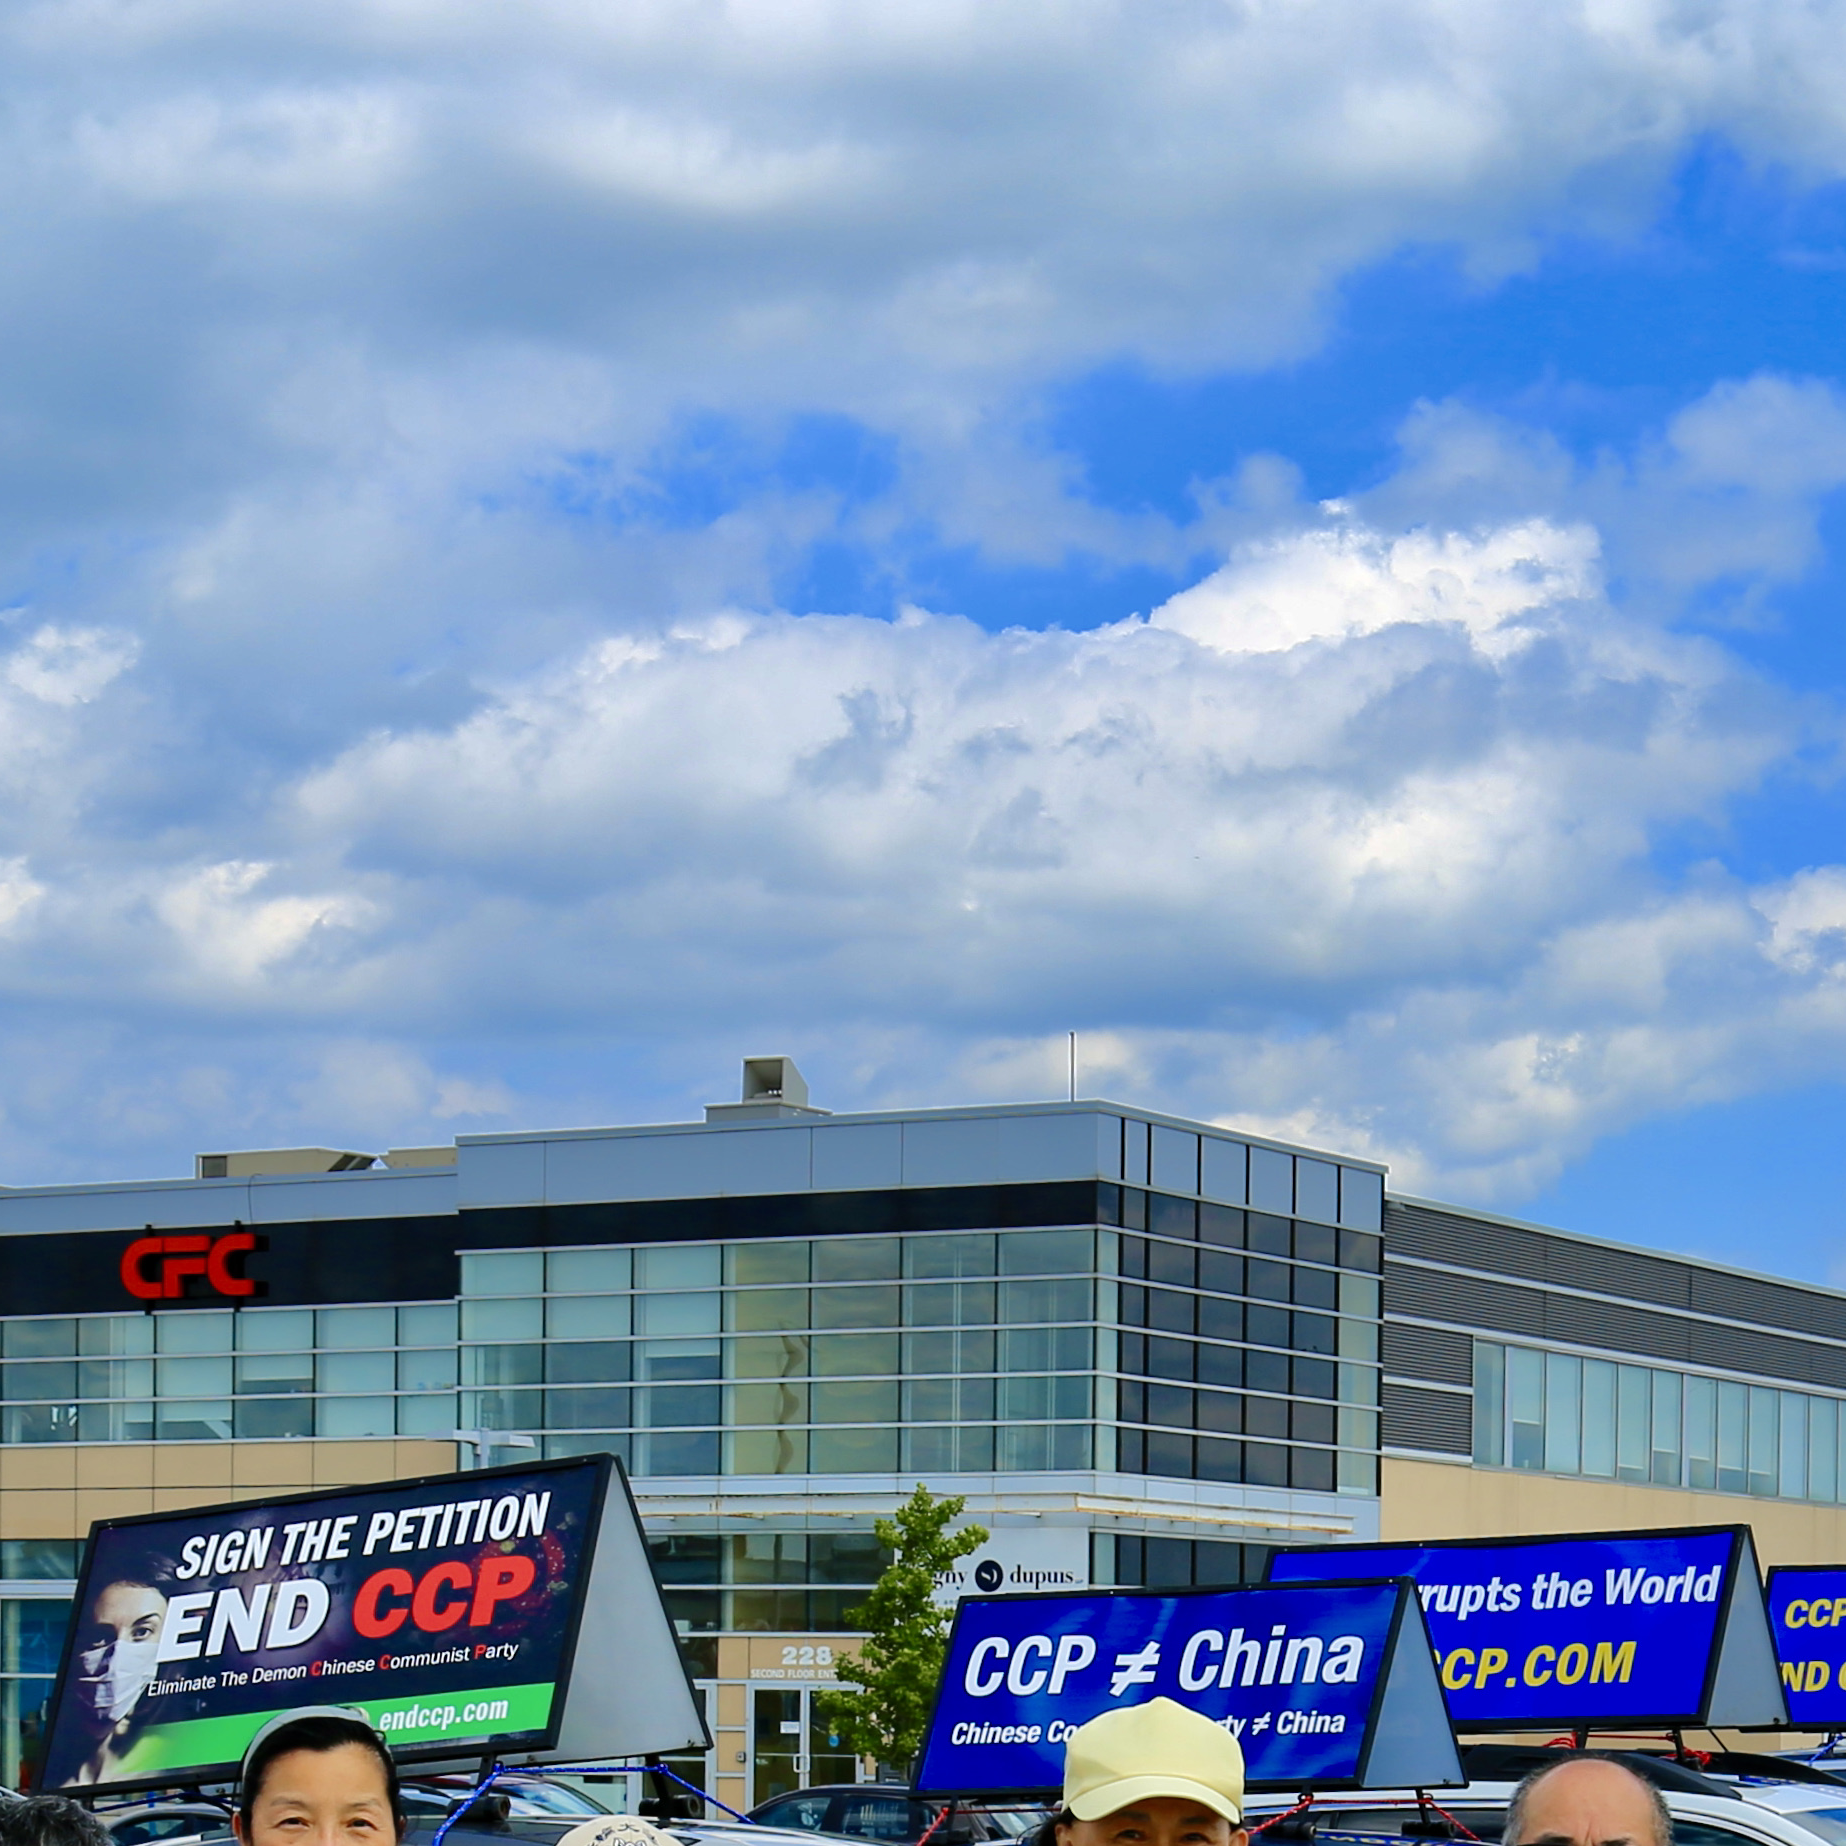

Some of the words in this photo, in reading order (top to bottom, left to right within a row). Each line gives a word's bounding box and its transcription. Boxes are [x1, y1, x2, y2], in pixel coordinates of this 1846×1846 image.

[120, 1234, 256, 1299] CFC
[176, 1527, 278, 1578] SIGN
[280, 1515, 358, 1563] THE
[364, 1491, 552, 1556] PETITION
[1010, 1564, 1074, 1589] dupuis
[1417, 1575, 1521, 1621] rupts
[1532, 1571, 1592, 1610] the
[1606, 1565, 1722, 1605] World
[157, 1578, 329, 1663] END
[353, 1555, 536, 1640] CCP
[148, 1673, 218, 1698] Eliminate
[221, 1669, 250, 1689] The
[251, 1664, 308, 1684] Demon
[311, 1656, 375, 1680] Chinese
[379, 1646, 471, 1673] Communist
[475, 1640, 519, 1666] Party
[751, 1669, 785, 1679] SECOND
[788, 1669, 815, 1679] FLOOR
[781, 1646, 833, 1665] 228
[964, 1633, 1096, 1698] CCP
[1179, 1625, 1364, 1692] China
[1434, 1640, 1637, 1691] CP.COM
[1780, 1661, 1830, 1692] ND
[379, 1699, 509, 1731] endccp.com
[952, 1720, 1041, 1746] Chinese
[1277, 1710, 1345, 1734] China
